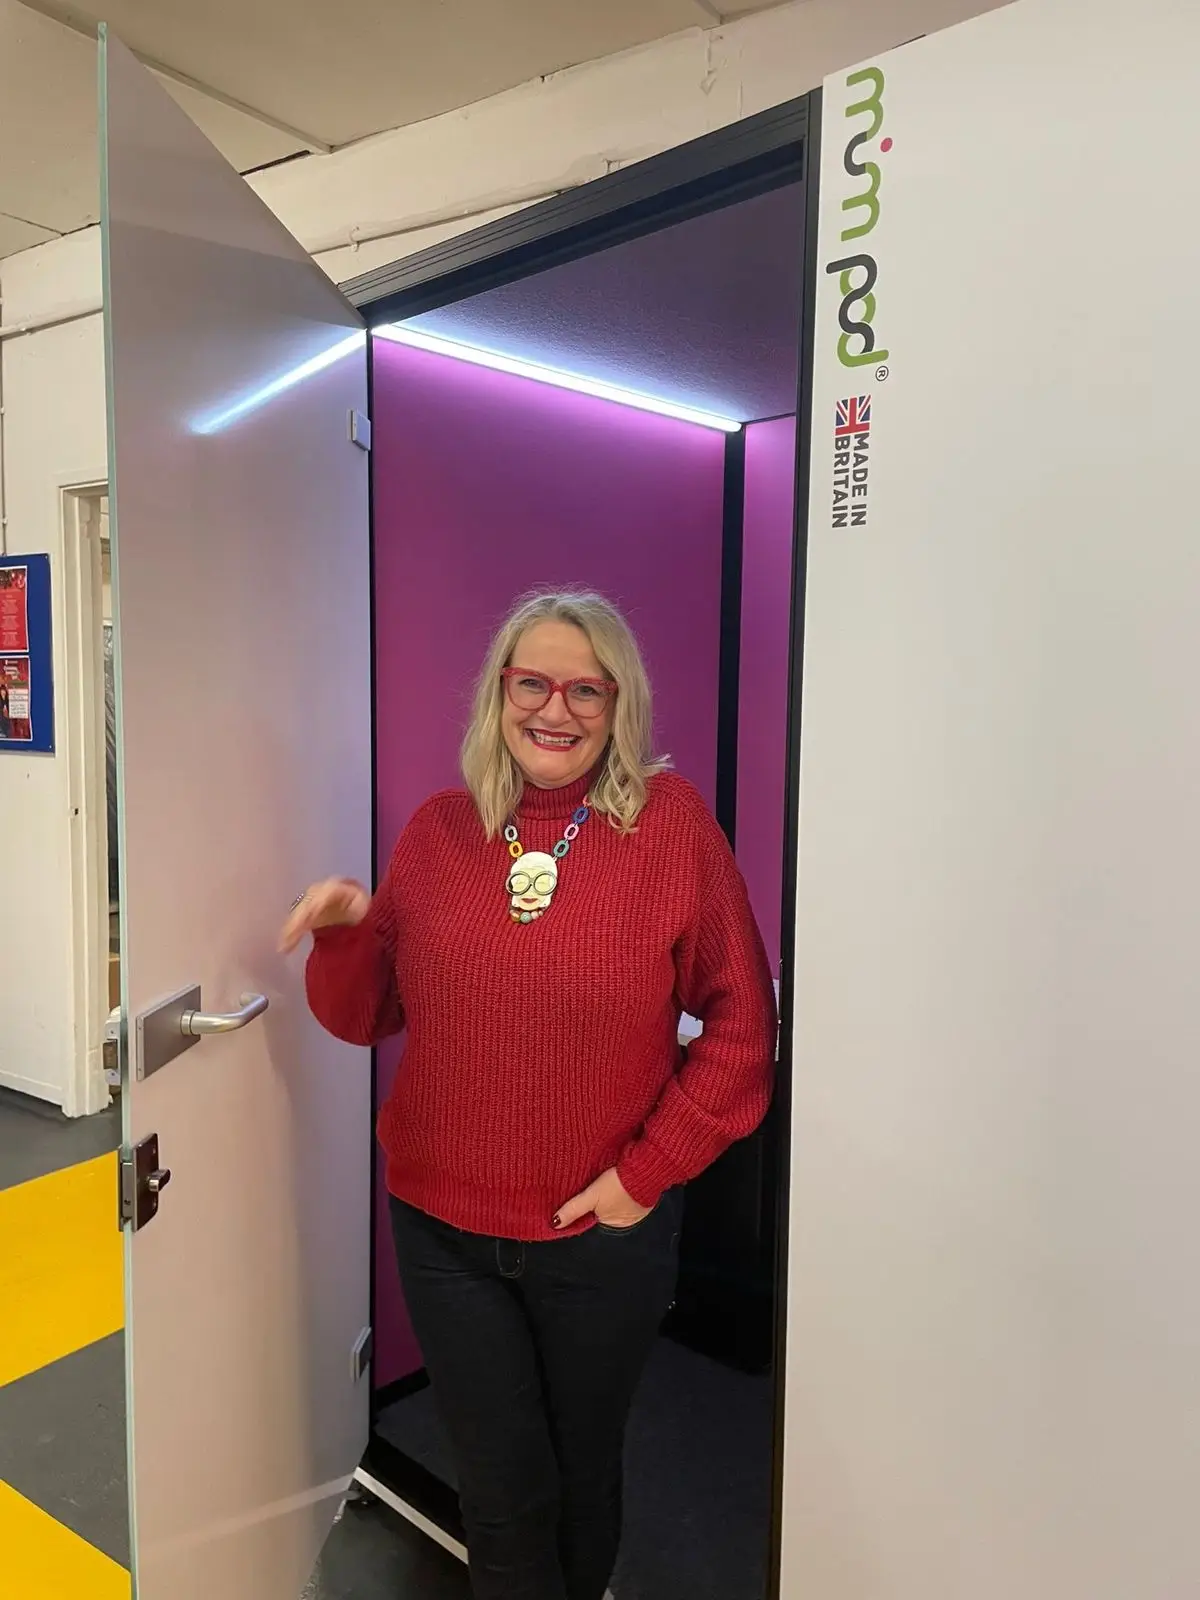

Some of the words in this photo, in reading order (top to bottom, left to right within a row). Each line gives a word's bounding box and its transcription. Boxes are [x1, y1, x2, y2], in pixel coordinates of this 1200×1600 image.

[832, 435, 850, 528] BRITAIN
[852, 432, 870, 498] MADE
[850, 503, 867, 526] IN
